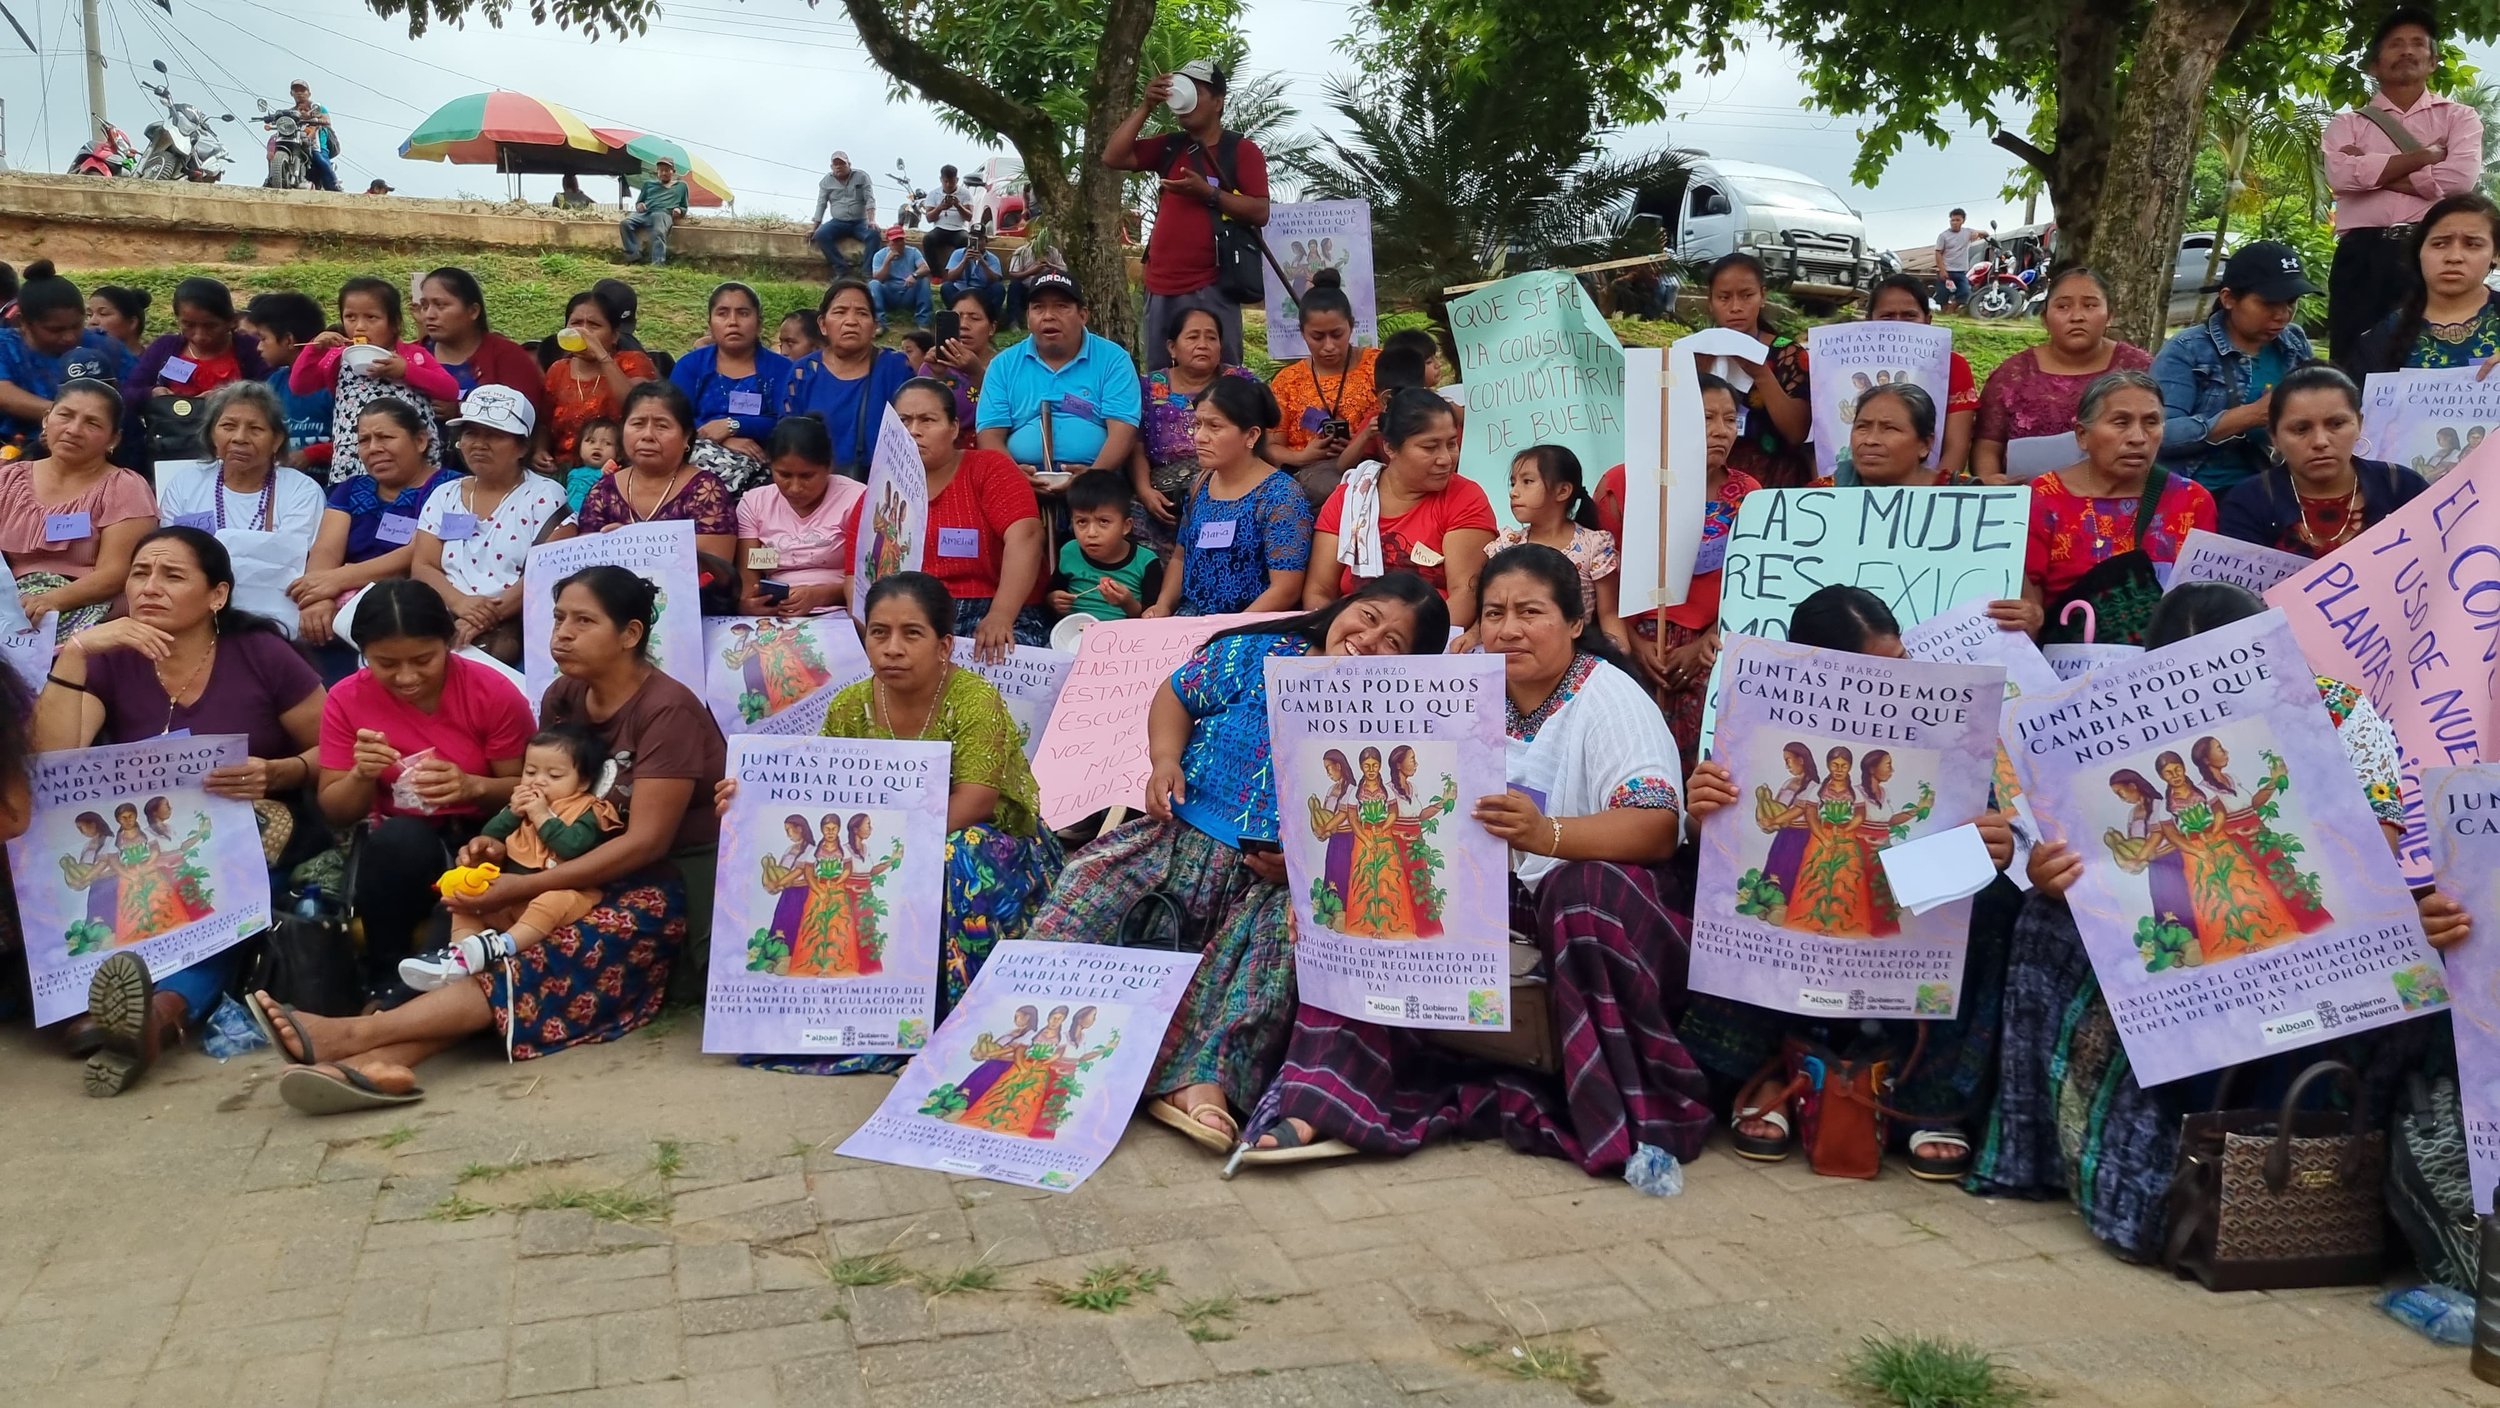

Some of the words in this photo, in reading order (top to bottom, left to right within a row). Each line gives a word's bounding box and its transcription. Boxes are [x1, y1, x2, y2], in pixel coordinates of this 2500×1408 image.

[1268, 220, 1314, 228] CAMBIAR
[1318, 218, 1331, 226] LO
[1335, 216, 1356, 226] QUE
[1271, 211, 1304, 220] UNTAS
[1035, 274, 1072, 287] JORDAN
[1453, 294, 1509, 329] QUE
[1517, 286, 1548, 321] SE
[1465, 342, 1491, 370] LA
[1498, 328, 1613, 365] CONSULTA
[1818, 333, 1872, 348] JUNTAS
[1878, 332, 1941, 348] PODEMOS
[1820, 344, 1887, 357] CAMBIAR
[1892, 344, 1910, 354] LO
[1914, 347, 1940, 360] QUE
[1840, 355, 1870, 366] NOS
[1469, 366, 1625, 413] COMUNITARIA
[2408, 382, 2474, 394] JUNTAS
[2408, 395, 2487, 406] CAMBIAR
[2428, 408, 2465, 418] NOS
[1486, 418, 1518, 455] DE
[1529, 403, 1621, 442] BUENA
[1732, 488, 1836, 548] LAS
[537, 543, 594, 561] JUNTAS
[601, 533, 680, 548] PODEMOS
[2372, 527, 2412, 556] Y
[537, 550, 610, 569] CAMBIAR
[616, 549, 638, 558] LO
[643, 545, 679, 558] QUE
[2192, 550, 2268, 577] JUNTAS
[2190, 564, 2274, 592] CAMBIA
[2394, 557, 2430, 632] USO
[1090, 630, 1147, 656] QUE
[1161, 631, 1210, 651] LAS
[1931, 645, 1956, 663] LO
[1961, 623, 1999, 648] QUE
[2302, 561, 2395, 711] PLANTAS
[1812, 657, 1819, 668] 8
[1823, 660, 1841, 671] DE
[1844, 664, 1894, 679] MARZO
[2407, 629, 2451, 690] DE
[993, 668, 1013, 681] LO
[1020, 673, 1052, 687] QUE
[1335, 668, 1341, 676] 8
[1346, 667, 1362, 677] DE
[1364, 667, 1407, 677] MARZO
[1736, 657, 1828, 688] JUNTAS
[1839, 675, 1974, 704] PODEMOS
[2092, 683, 2100, 692] 8
[2103, 676, 2122, 689] DE
[2127, 656, 2176, 681] MARZO
[1277, 678, 1351, 695] JUNTAS
[1362, 678, 1480, 693] PODEMOS
[2017, 690, 2119, 741] JUNTAS
[2128, 640, 2267, 700] PODEMOS
[1280, 698, 1374, 714] CAMBIAR
[1385, 699, 1415, 714] LO
[1426, 698, 1476, 717] QUE
[1737, 679, 1852, 714] CAMBIAR
[1862, 701, 1898, 719] LO
[1909, 706, 1967, 727] QUE
[2030, 702, 2155, 756] CAMBIAR
[2164, 688, 2200, 712] LO
[2212, 663, 2273, 696] QUE
[1307, 719, 1349, 733] NOS
[1359, 719, 1435, 734] DUELE
[1767, 706, 1818, 728] NOS
[1830, 716, 1917, 741] DUELE
[2074, 733, 2131, 765] NOS
[2141, 700, 2233, 743] DUELE
[114, 745, 226, 770] PODEMOS
[1050, 740, 1096, 761] VOZ
[741, 753, 819, 768] JUNTAS
[829, 756, 930, 772] PODEMOS
[37, 770, 127, 793] AMBIAR
[138, 766, 166, 779] LO
[54, 788, 102, 805] NOS
[113, 777, 186, 796] DUELE
[742, 769, 838, 786] CAMBIAR
[848, 775, 874, 788] LO
[883, 775, 926, 792] QUE
[770, 788, 813, 802] NOS
[823, 791, 890, 805] DUELE
[1296, 943, 1357, 966] REGLAMENTO
[1361, 959, 1377, 968] DE
[1381, 960, 1473, 974] REGULACIÓN
[1479, 964, 1497, 974] DE
[1343, 944, 1355, 955] EL
[1359, 947, 1466, 962] CUMPLIMIENTO
[1471, 951, 1499, 962] DEL
[2208, 974, 2228, 988] EL
[2233, 933, 2372, 980] CUMPLIMIENTO
[2378, 922, 2413, 939] DEL
[1000, 954, 1069, 968] JUNTAS
[1076, 957, 1175, 977] PODEMOS
[1297, 955, 1325, 970] VENTA
[1326, 964, 1339, 974] DE
[1342, 966, 1391, 982] BEBIDAS
[1394, 972, 1497, 986] ALCOHÓLICAS
[994, 967, 1081, 983] CAMBIAR
[1088, 973, 1113, 985] LO
[1121, 975, 1164, 990] QUE
[1367, 983, 1387, 993] YA!
[2118, 984, 2234, 1025] REGLAMENTO
[2239, 977, 2262, 992] DE
[2268, 942, 2386, 985] REGULACIÓN
[2393, 934, 2418, 951] DE
[1013, 982, 1052, 996] NOS
[1059, 985, 1125, 999] DUELE
[2124, 1014, 2182, 1036] VENTA
[2186, 1006, 2208, 1022] DE
[2214, 985, 2287, 1014] BEBIDAS
[2293, 950, 2422, 994] ALCOHÓLICAS
[1373, 1002, 1401, 1013] alboan
[1422, 1004, 1458, 1013] Gobierno
[2256, 999, 2287, 1016] YA!
[2340, 995, 2387, 1013] Gobierno
[2345, 1012, 2359, 1023] de
[2358, 1002, 2400, 1021] Navarra
[1422, 1013, 1433, 1021] de
[1433, 1013, 1466, 1022] Navarra
[2276, 1017, 2315, 1036] alboan
